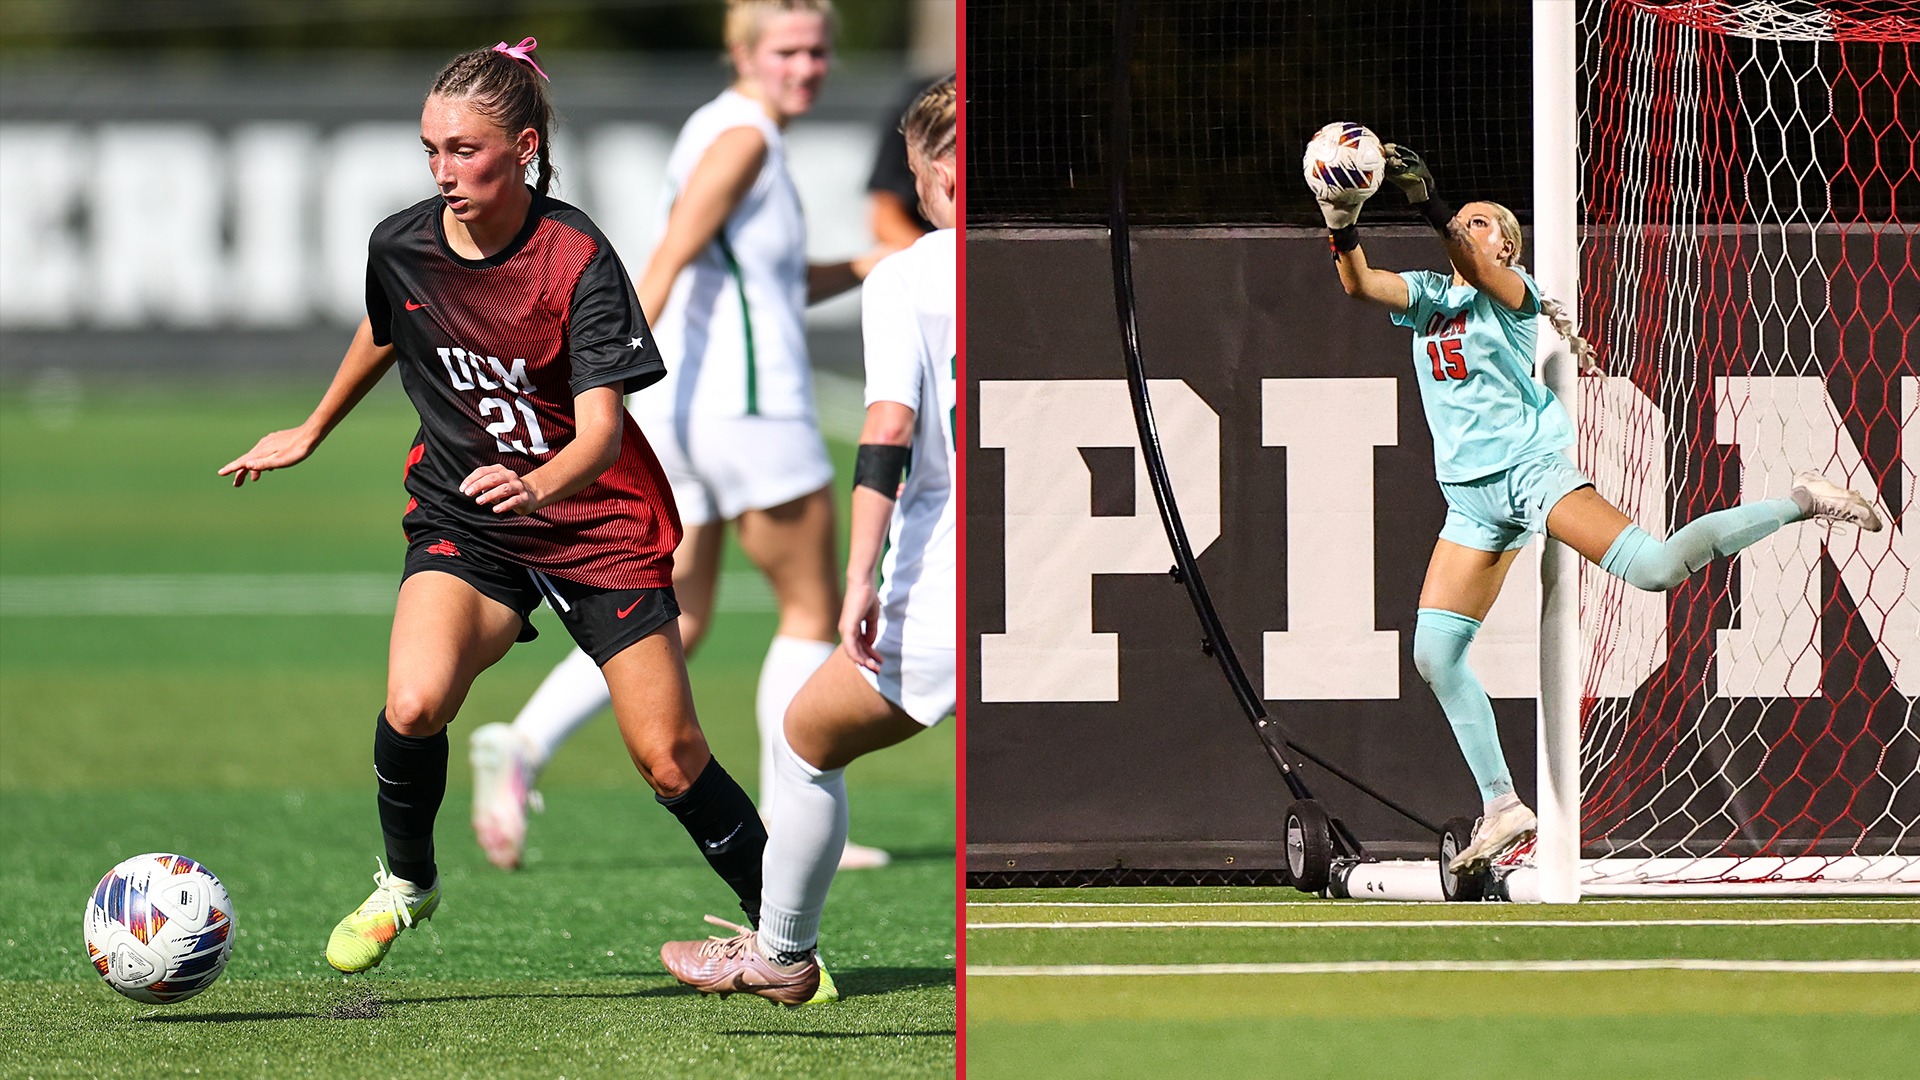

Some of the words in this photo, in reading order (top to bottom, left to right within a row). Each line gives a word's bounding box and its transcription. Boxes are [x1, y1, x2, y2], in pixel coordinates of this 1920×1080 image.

[436, 346, 538, 395] UCM
[1426, 338, 1469, 382] 15
[477, 395, 550, 456] 21
